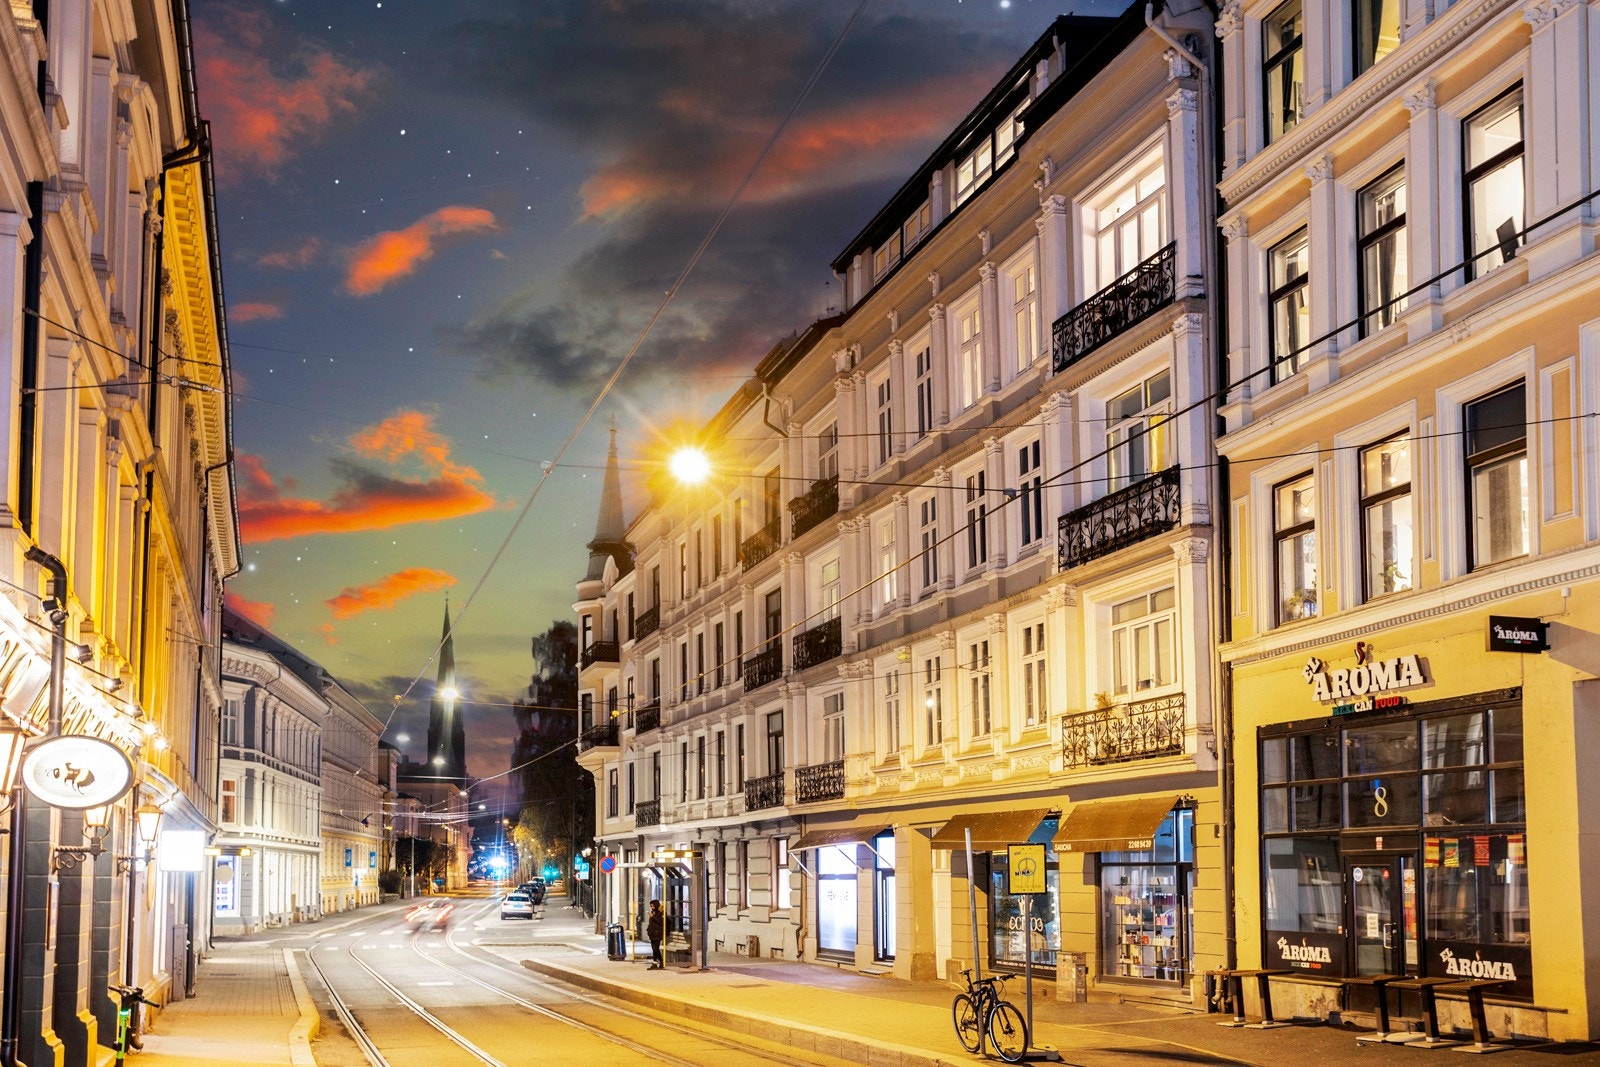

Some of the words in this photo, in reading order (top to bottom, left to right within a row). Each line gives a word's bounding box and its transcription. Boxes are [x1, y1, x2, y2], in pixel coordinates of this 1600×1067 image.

[1302, 657, 1322, 684] EL
[1332, 699, 1373, 716] MEXICAN
[1374, 695, 1401, 709] FOOD
[1374, 786, 1388, 817] 8
[1439, 947, 1454, 963] EL
